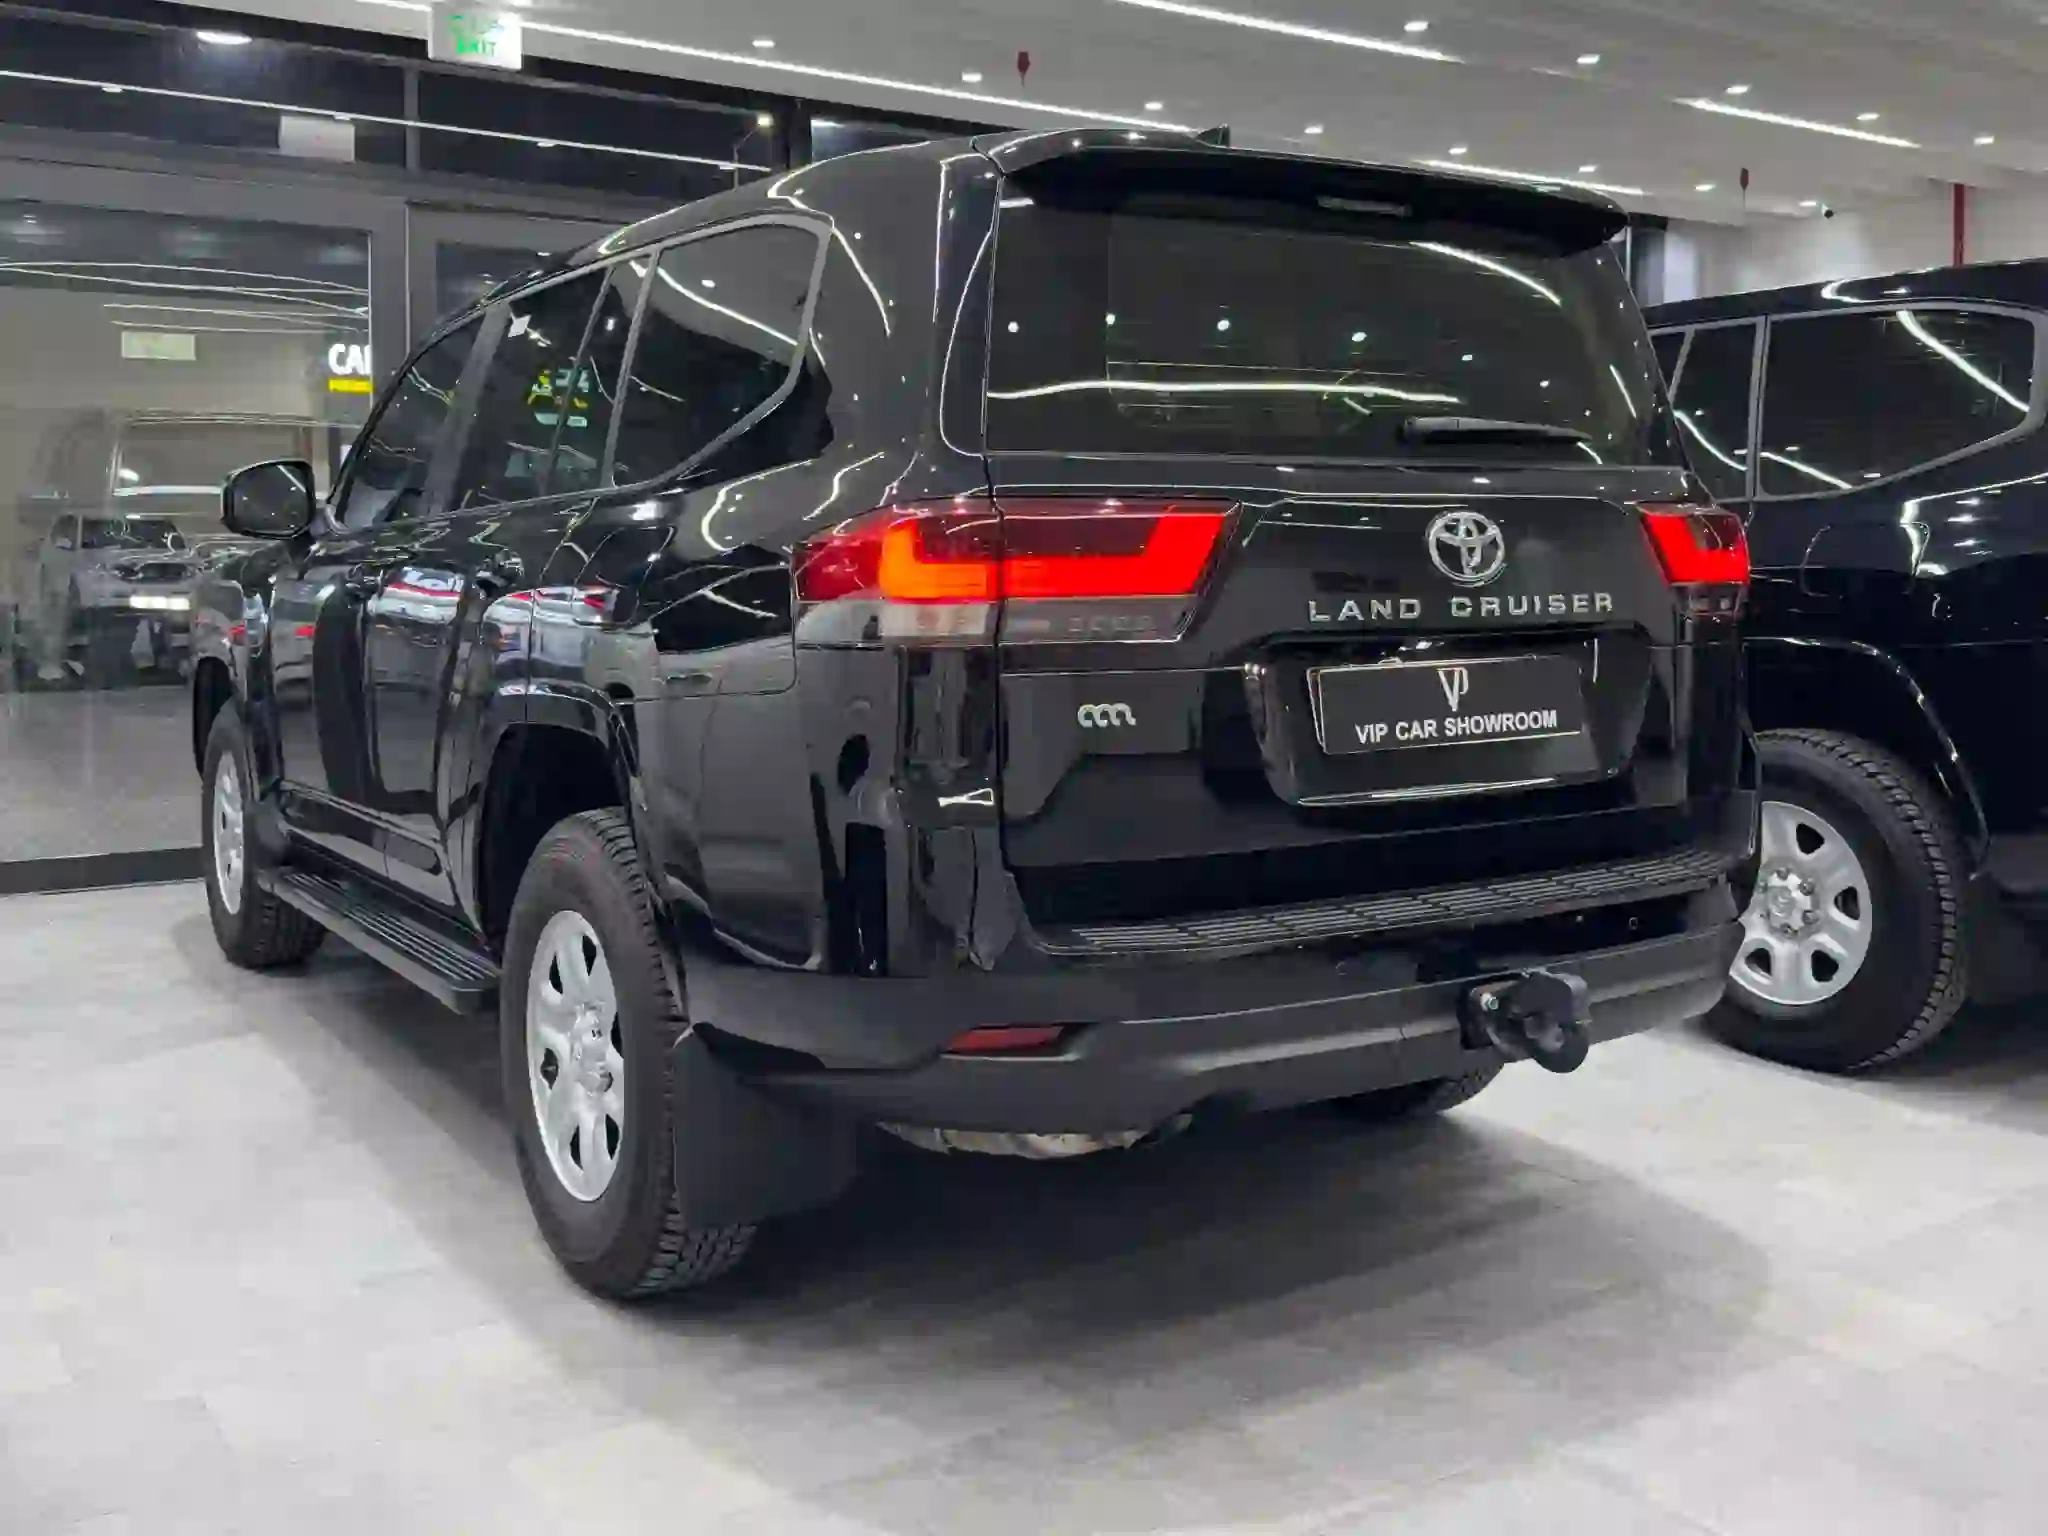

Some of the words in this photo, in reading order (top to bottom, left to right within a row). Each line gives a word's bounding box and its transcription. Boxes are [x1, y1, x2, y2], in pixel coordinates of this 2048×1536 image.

[1307, 598, 1421, 622] LAND
[1450, 592, 1613, 617] CRUISER
[1354, 722, 1389, 744] VIP
[1395, 719, 1438, 741] CAR
[1444, 709, 1558, 736] SHOWROOM
